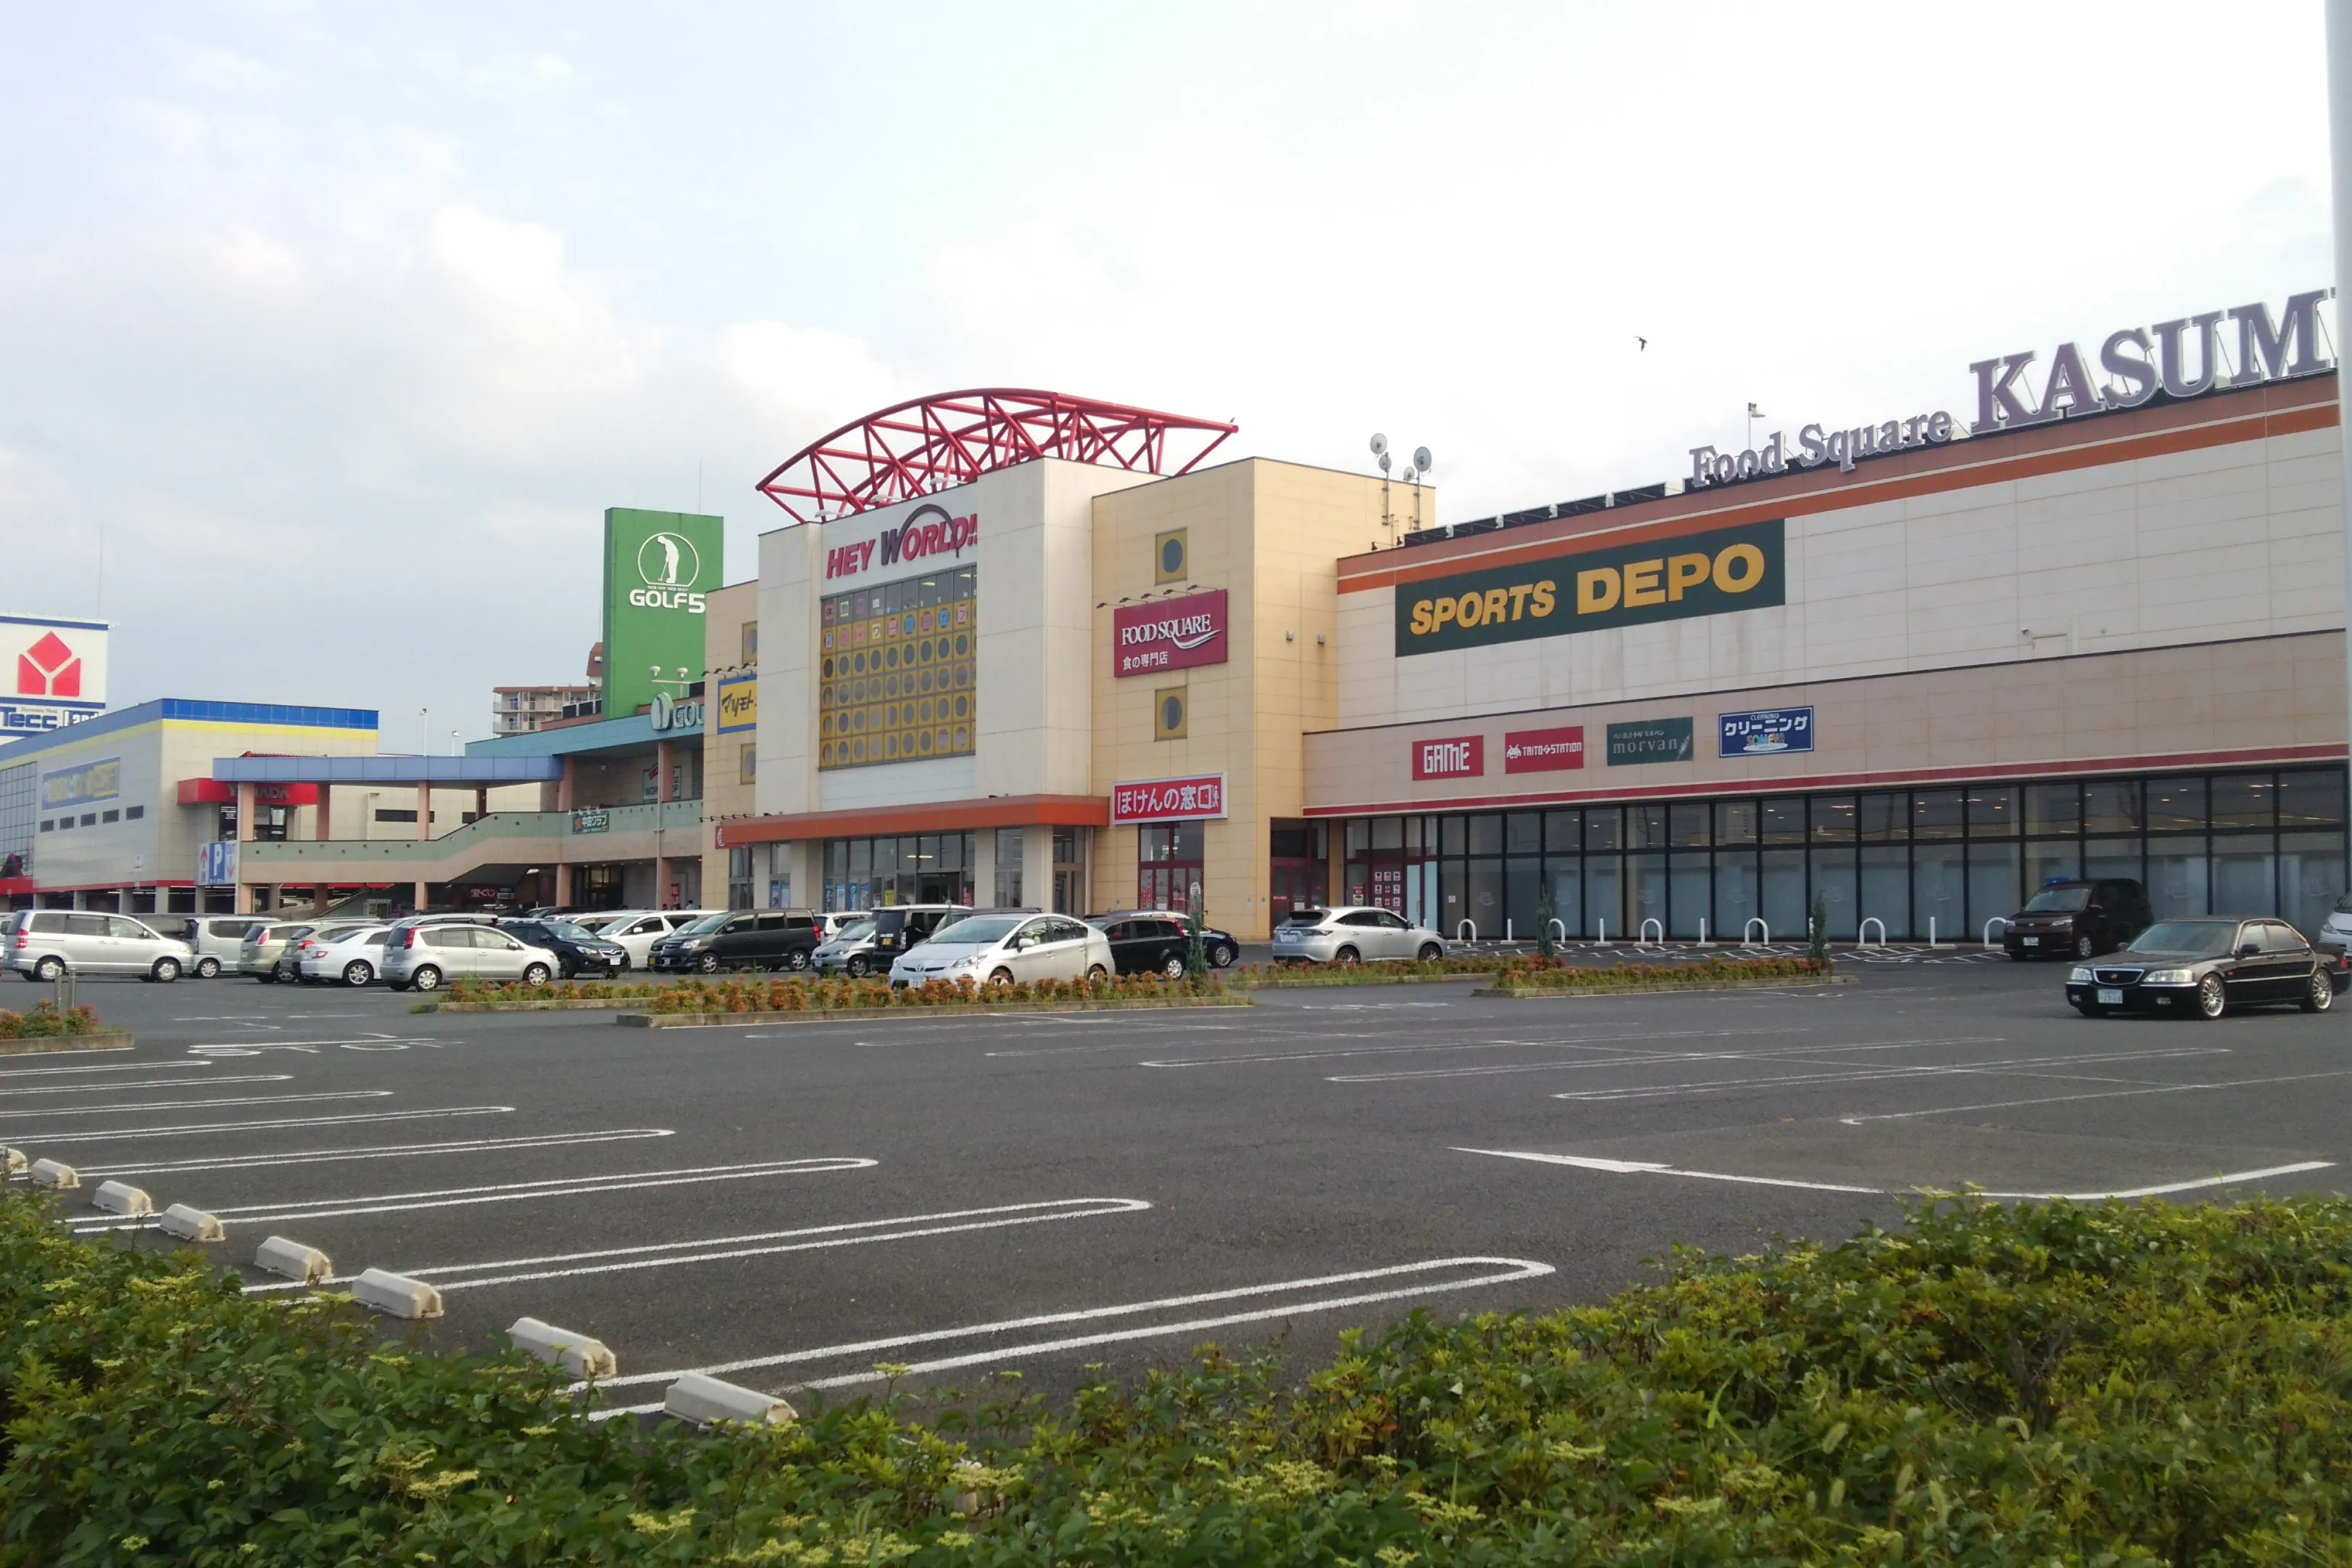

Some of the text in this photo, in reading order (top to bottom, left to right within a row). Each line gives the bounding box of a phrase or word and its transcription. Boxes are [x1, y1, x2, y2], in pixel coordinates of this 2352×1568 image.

[1689, 287, 2338, 488] Food Square KASUM
[826, 539, 876, 579] HEY
[629, 589, 706, 613] GOLF5
[1410, 543, 1765, 635] SPORTS DEPO
[1121, 614, 1212, 645] FOOD SQUARE
[1122, 651, 1168, 671] 食の専門店
[1724, 716, 1808, 737] クリーニング
[1750, 712, 1780, 721] CLEANING
[1424, 742, 1470, 773] GAME
[1522, 742, 1582, 756] TAITO STATION
[1613, 738, 1678, 754] morvan
[1117, 785, 1213, 814] ほけんの窓口
[470, 889, 496, 897] 宝くじ
